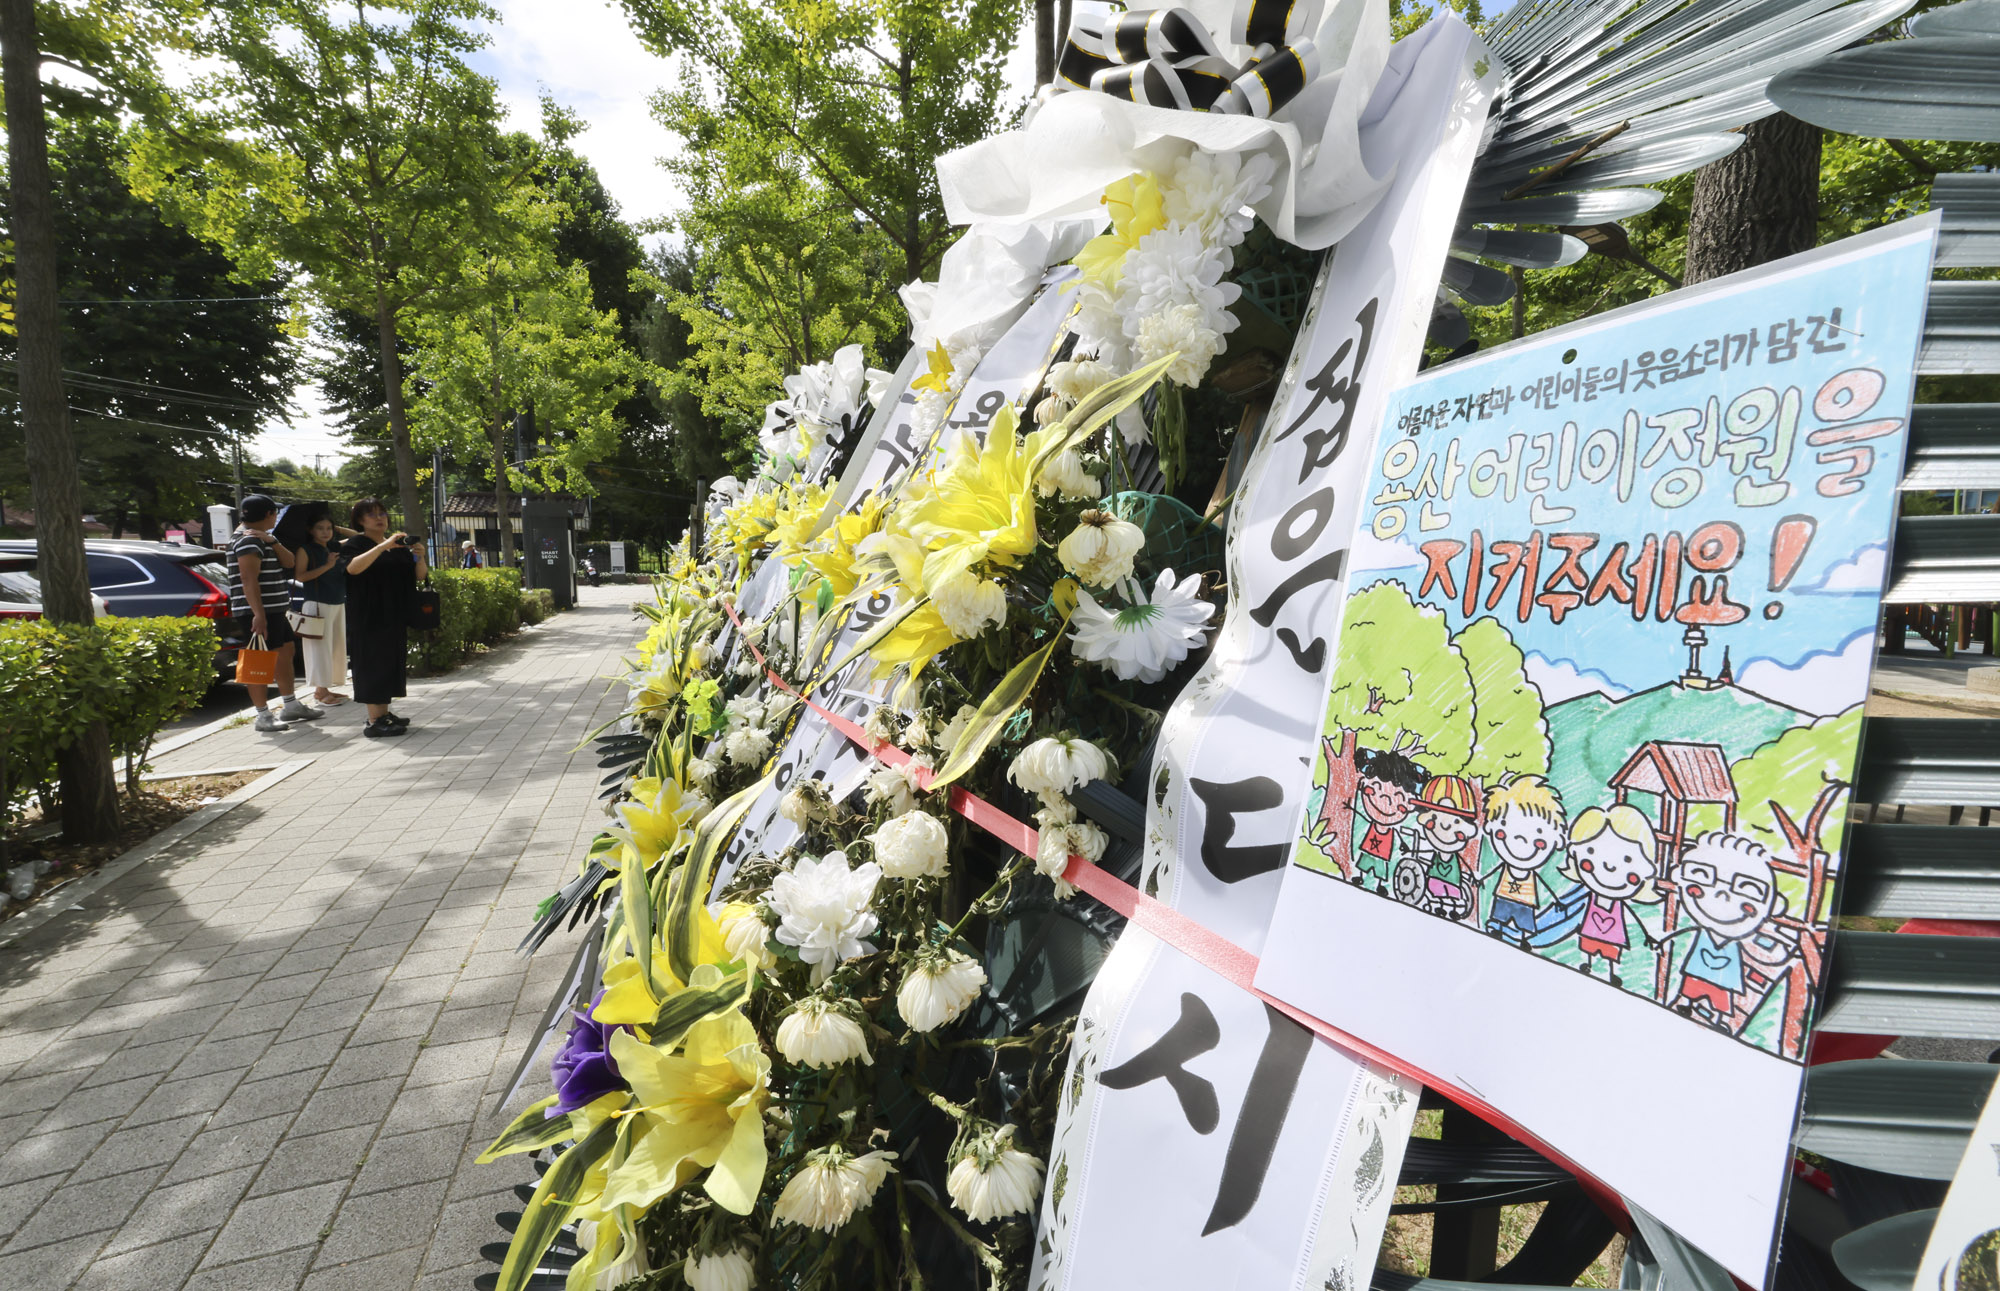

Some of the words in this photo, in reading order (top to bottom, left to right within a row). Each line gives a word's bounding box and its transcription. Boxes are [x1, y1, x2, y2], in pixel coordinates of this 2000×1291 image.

[1520, 358, 1628, 409] 어린이들의
[1629, 328, 1760, 392] 웃음소리가
[1767, 307, 1846, 364] 담긴
[1419, 513, 1817, 625] 지켜주세요!
